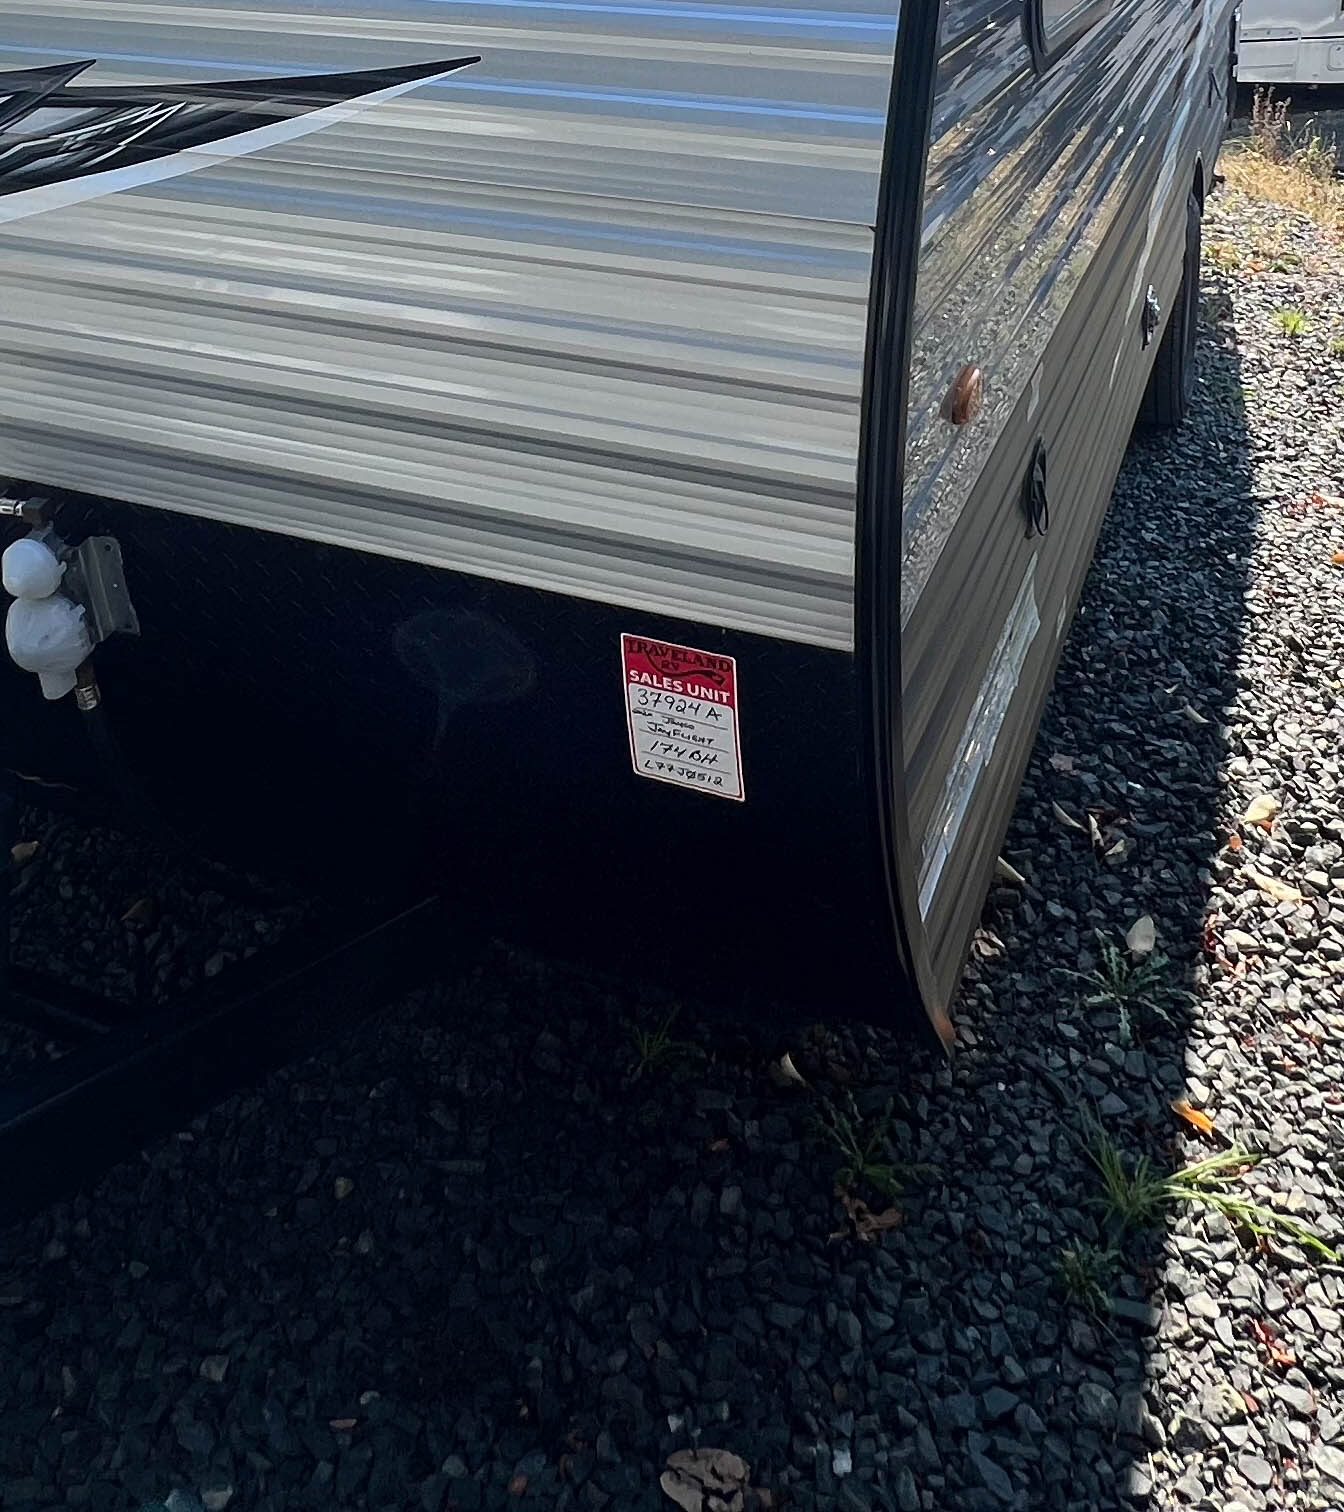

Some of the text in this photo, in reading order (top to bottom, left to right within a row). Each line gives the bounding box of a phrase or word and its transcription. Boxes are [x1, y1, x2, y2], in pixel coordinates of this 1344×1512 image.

[627, 640, 732, 673] TRAVELAND
[661, 660, 680, 671] RV
[629, 669, 731, 704] SALES UNIT
